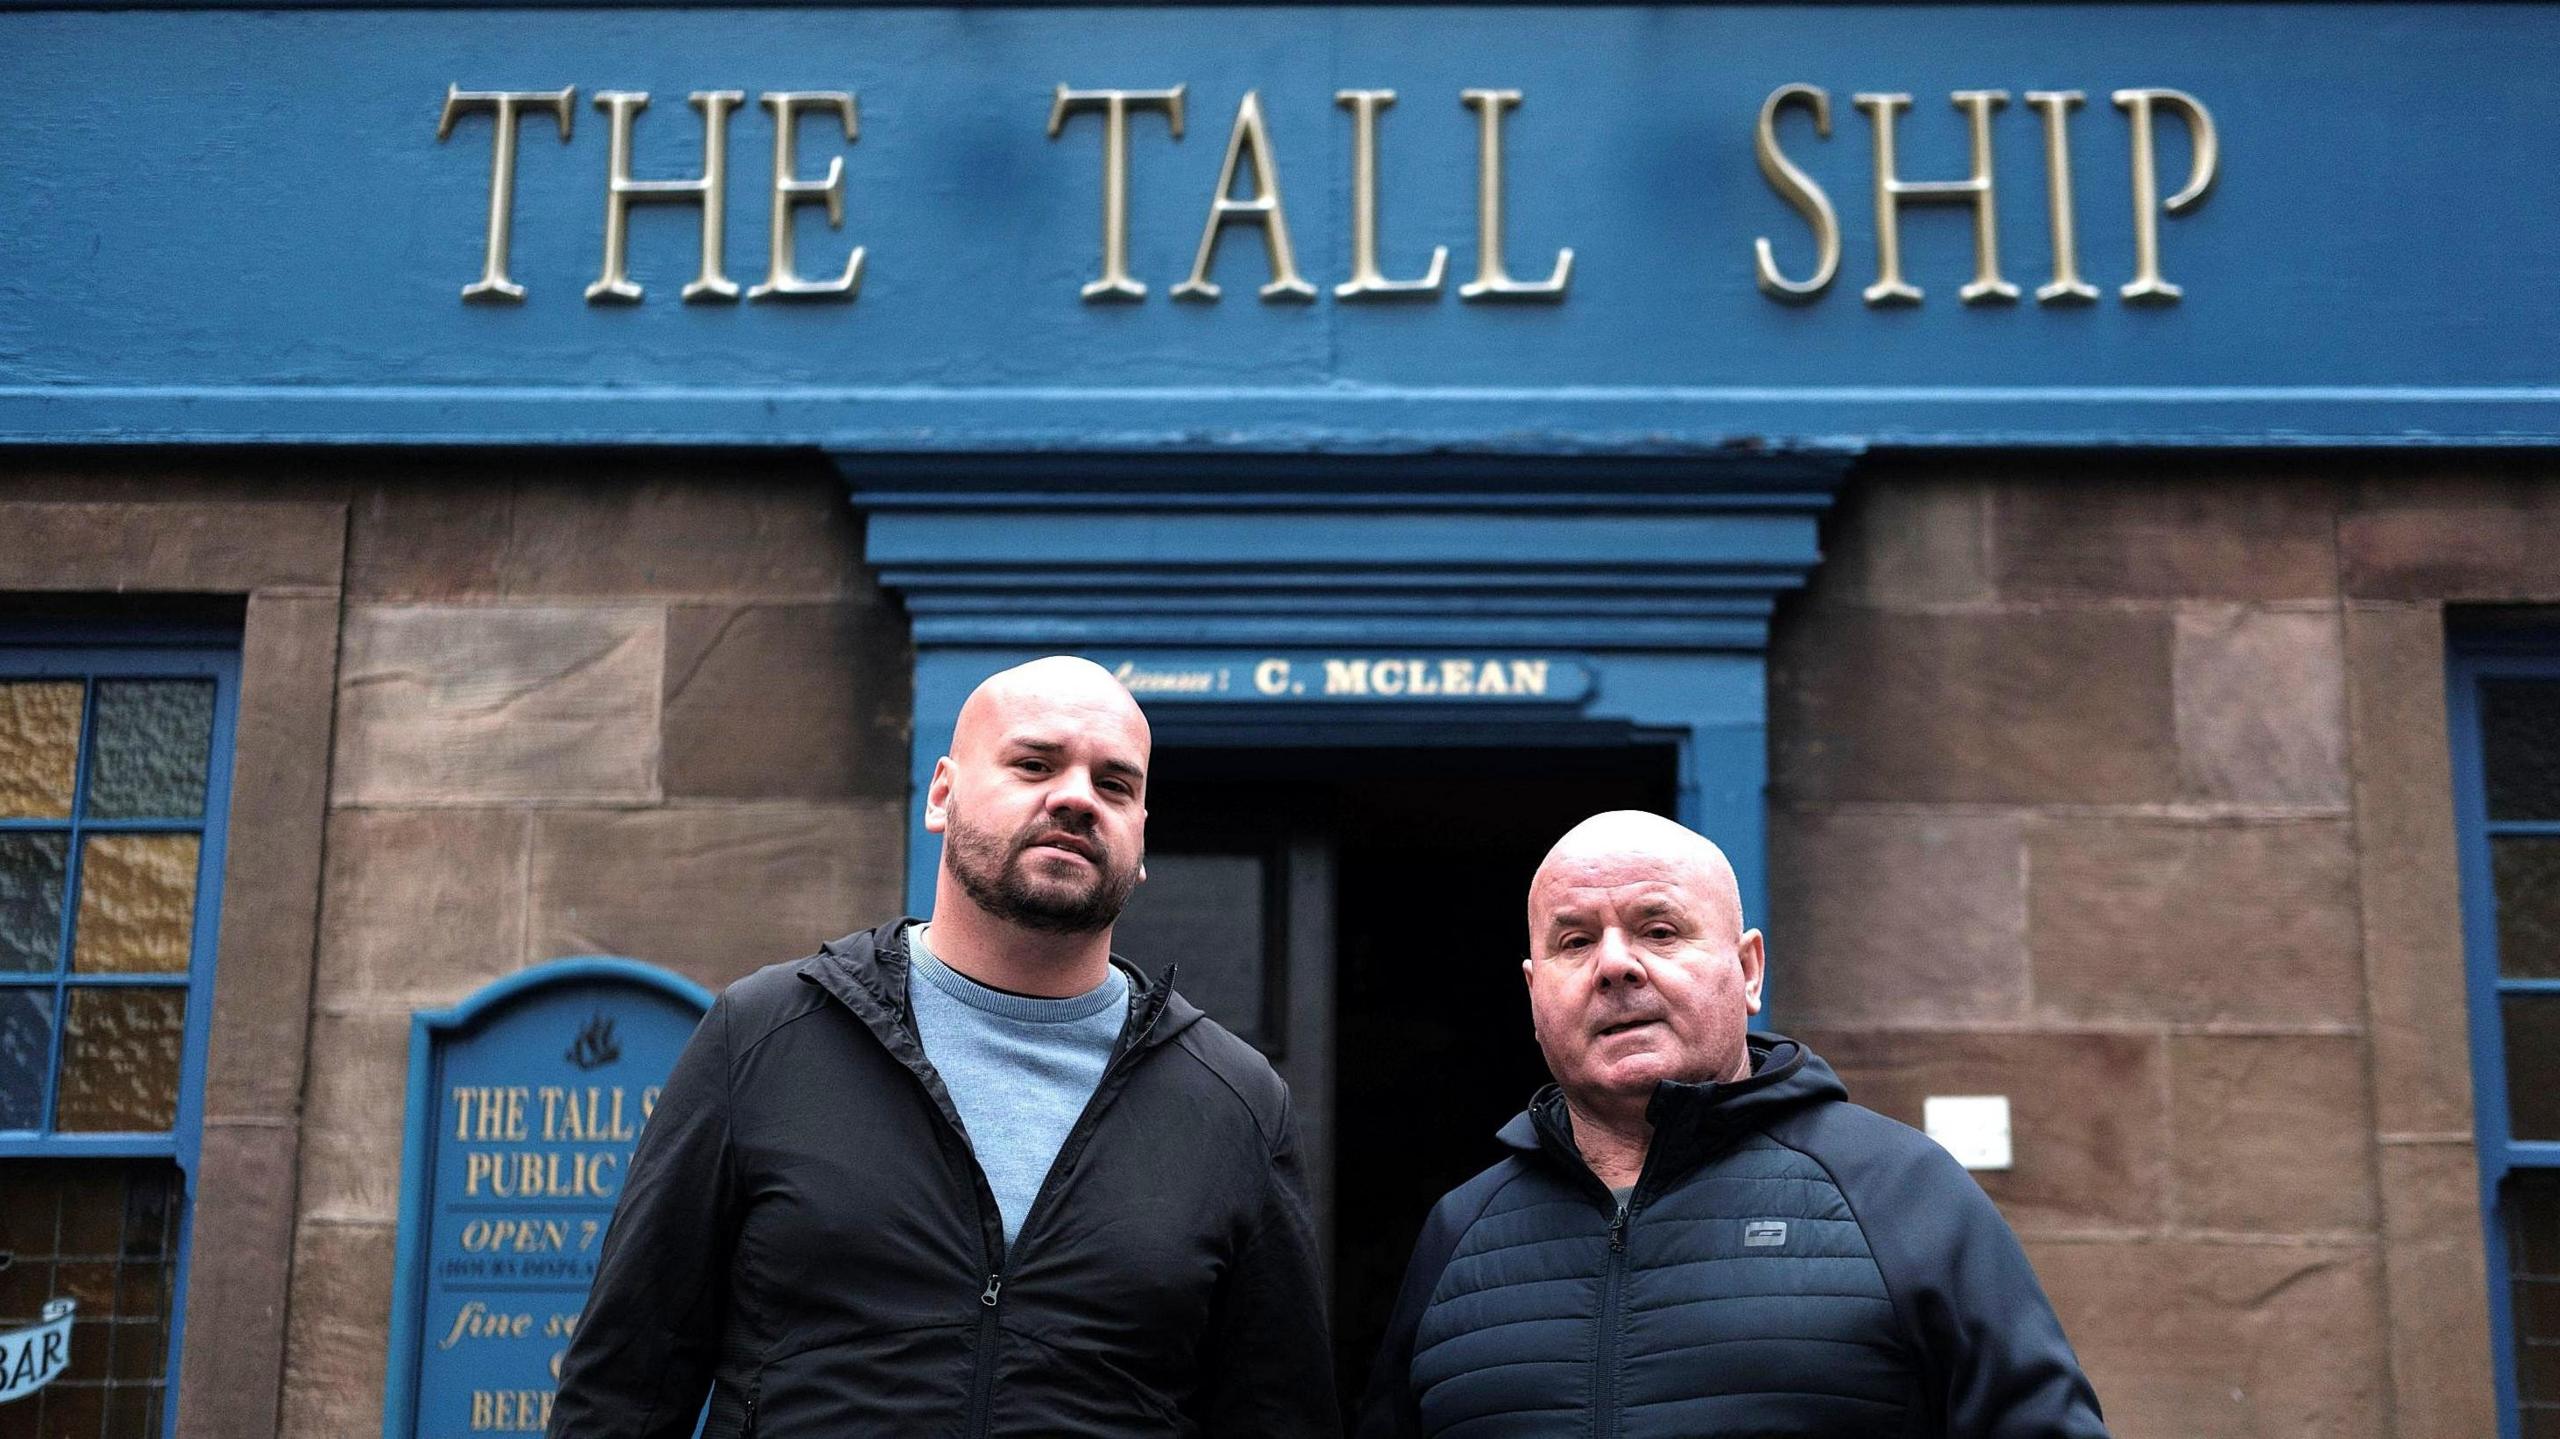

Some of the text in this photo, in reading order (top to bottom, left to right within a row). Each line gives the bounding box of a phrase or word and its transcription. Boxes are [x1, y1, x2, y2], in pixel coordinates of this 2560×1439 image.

[437, 82, 2218, 304] THE TALL SHIP
[1254, 660, 1305, 695] C.
[1324, 659, 1549, 695] MCLEAN
[453, 1086, 529, 1141] THE
[538, 1086, 634, 1142] TALL
[465, 1152, 617, 1198] PUBLIC
[461, 1218, 599, 1252] OPEN 7
[438, 1301, 533, 1349] fine
